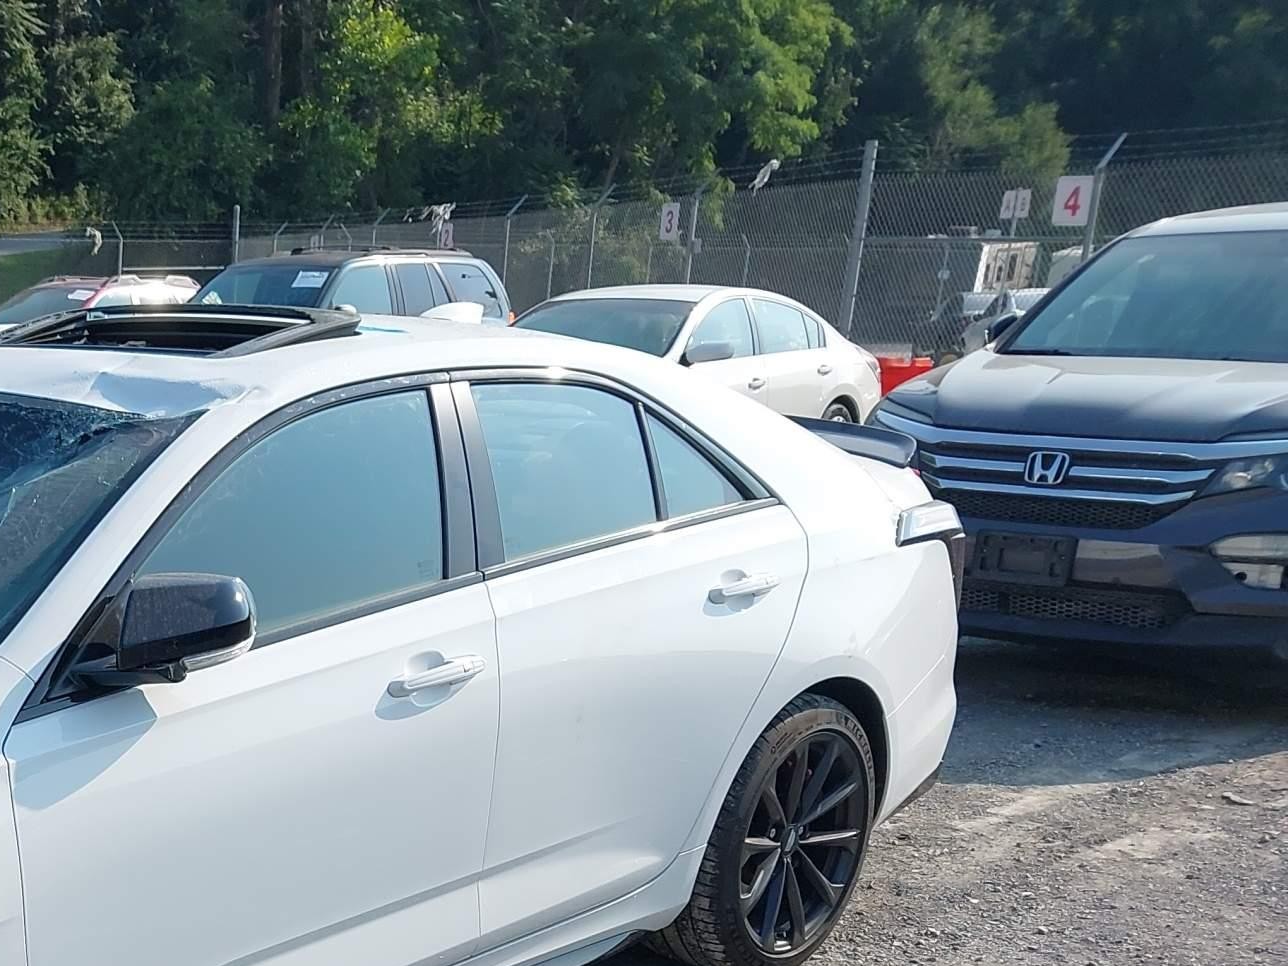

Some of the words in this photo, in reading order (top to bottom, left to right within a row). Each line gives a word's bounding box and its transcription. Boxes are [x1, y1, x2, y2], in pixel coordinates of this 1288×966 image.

[1063, 185, 1081, 217] 4
[665, 209, 674, 234] 3
[443, 229, 450, 247] 2
